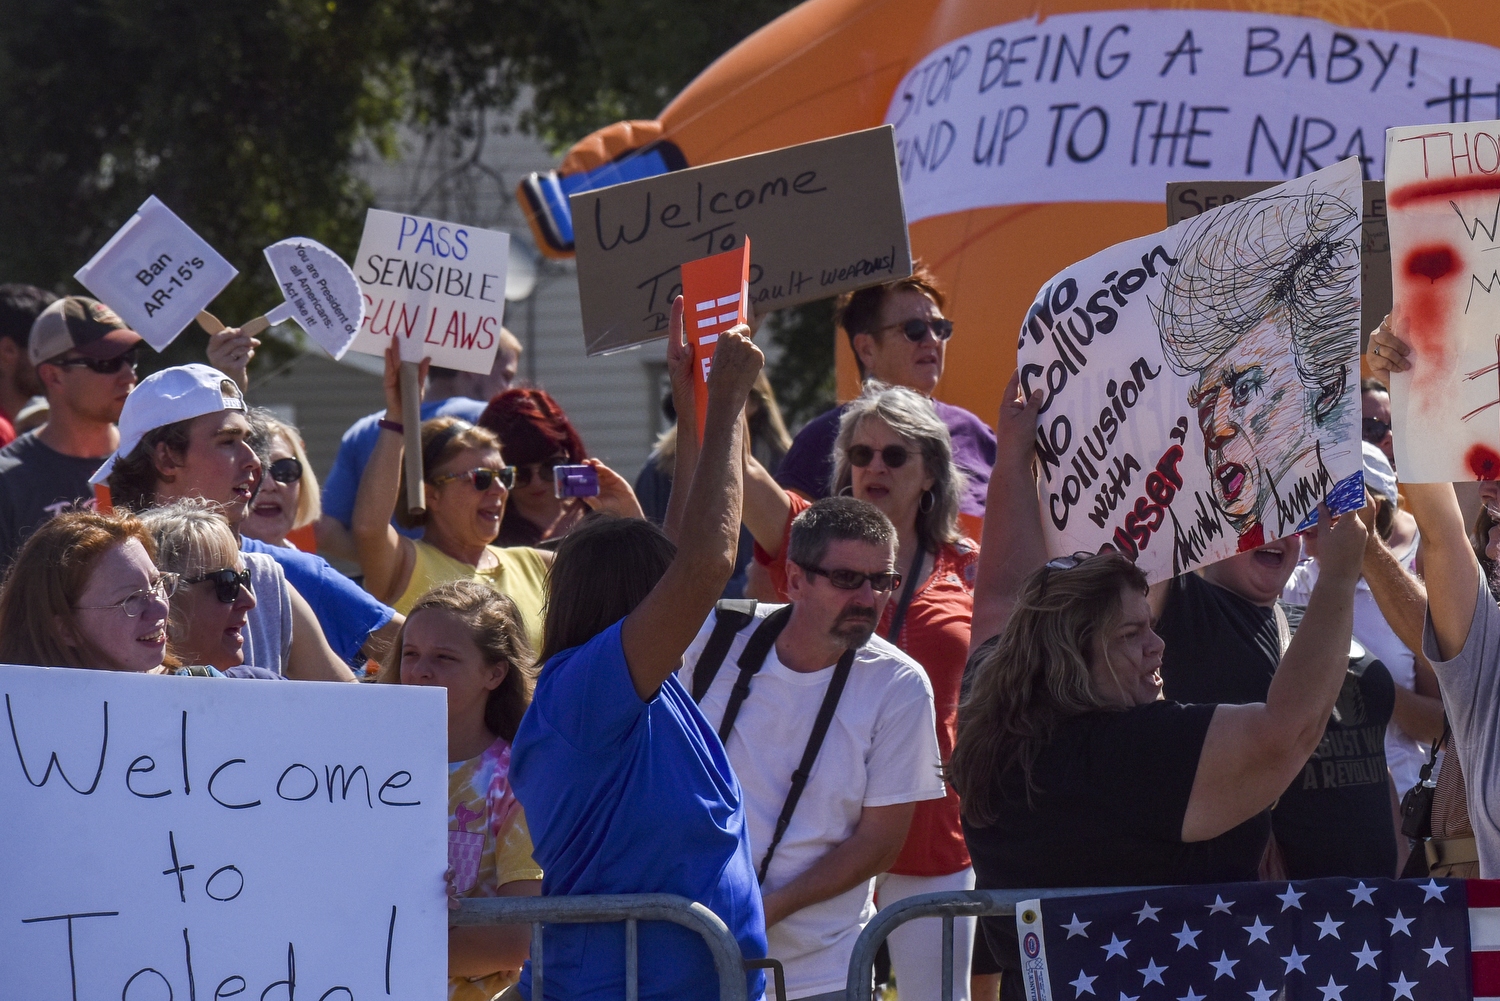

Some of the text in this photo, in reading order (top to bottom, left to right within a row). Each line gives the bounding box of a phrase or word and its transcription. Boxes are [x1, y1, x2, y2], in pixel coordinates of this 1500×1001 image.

[895, 24, 1418, 129] STOP BEING A BABY!
[973, 104, 1029, 167] UP
[1047, 102, 1110, 167] TO
[1131, 99, 1230, 168] THE
[1245, 113, 1381, 180] NRA
[397, 216, 469, 261] PASS
[595, 171, 827, 250] Welcome
[687, 221, 737, 254] To
[135, 252, 173, 287] Ban
[142, 256, 205, 318] AR-15's
[289, 264, 334, 330] all Americans:
[294, 242, 357, 335] You are President of
[359, 254, 499, 303] SENSIBLE
[283, 280, 318, 328] Act like it!
[424, 306, 497, 350] LAWS
[1089, 452, 1141, 528] with
[5, 693, 421, 809] Welcome
[163, 831, 244, 903] to
